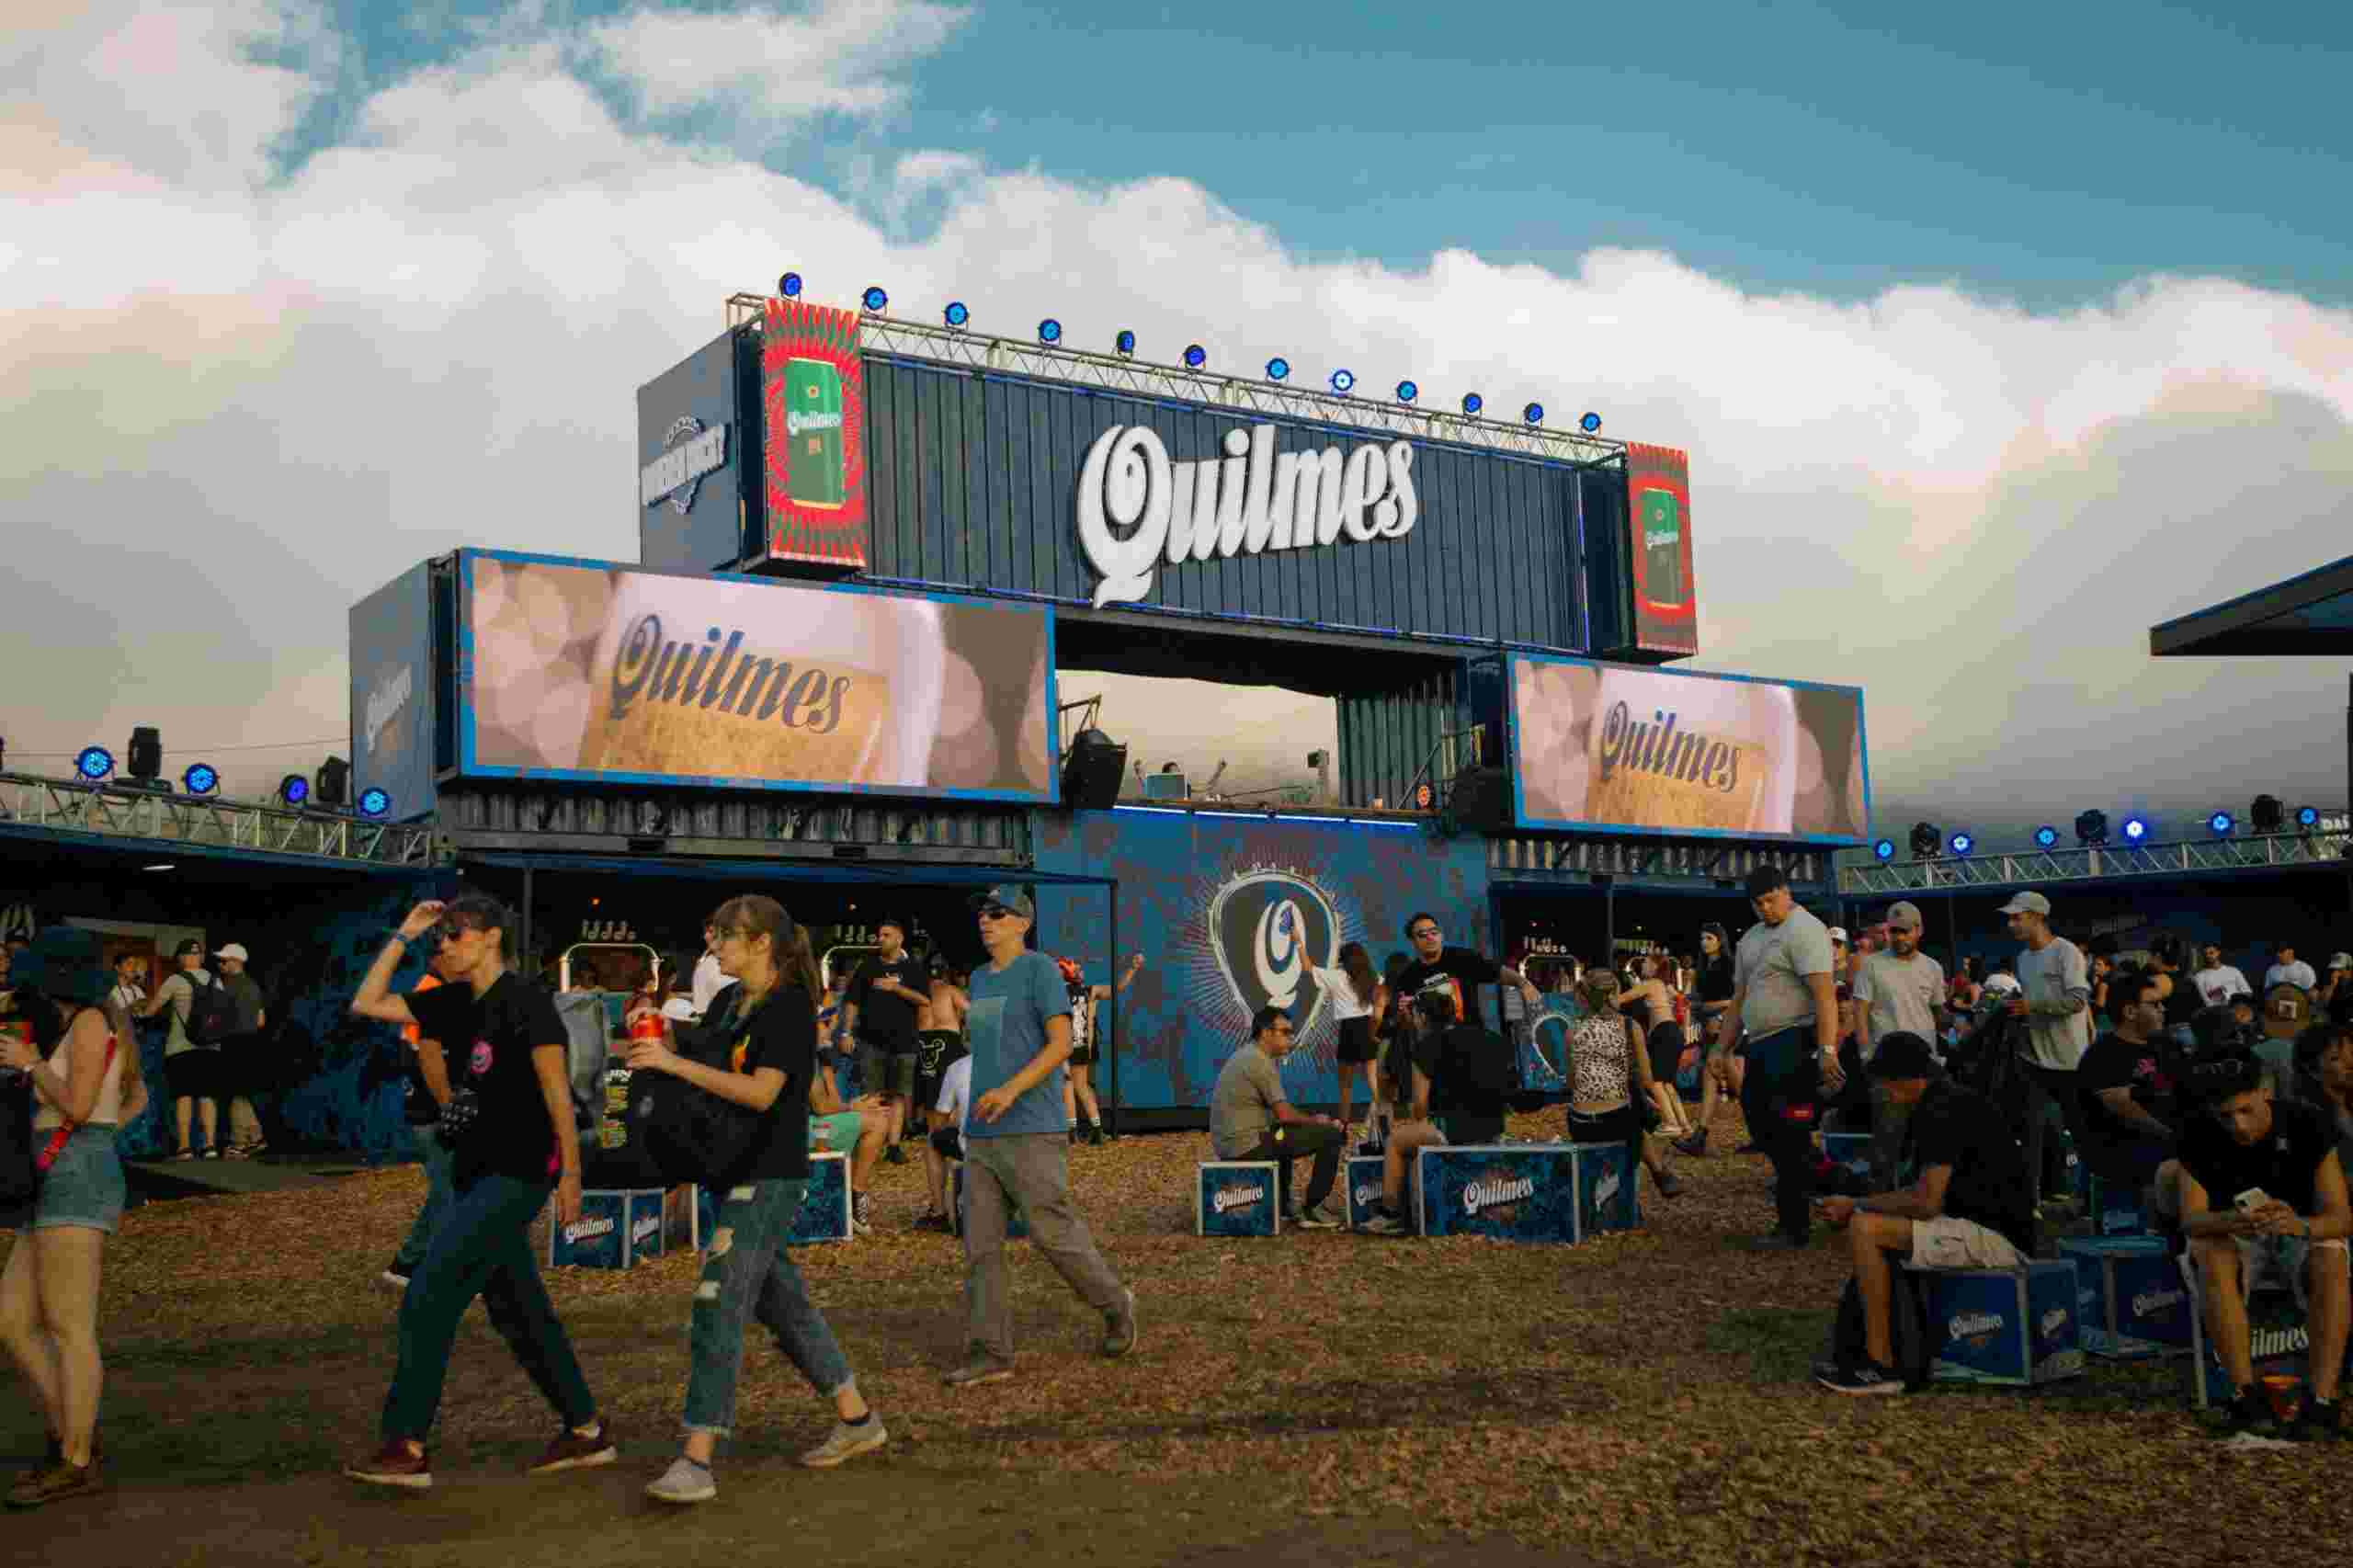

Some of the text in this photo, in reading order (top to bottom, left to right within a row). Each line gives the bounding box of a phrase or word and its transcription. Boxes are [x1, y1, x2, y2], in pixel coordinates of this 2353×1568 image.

[1076, 424, 1417, 609] Quilmes
[610, 613, 851, 734] Quilmes
[1601, 699, 1741, 793] Quilmes
[1463, 1176, 1534, 1214] Quilmes
[2249, 1325, 2310, 1360] ilmes
